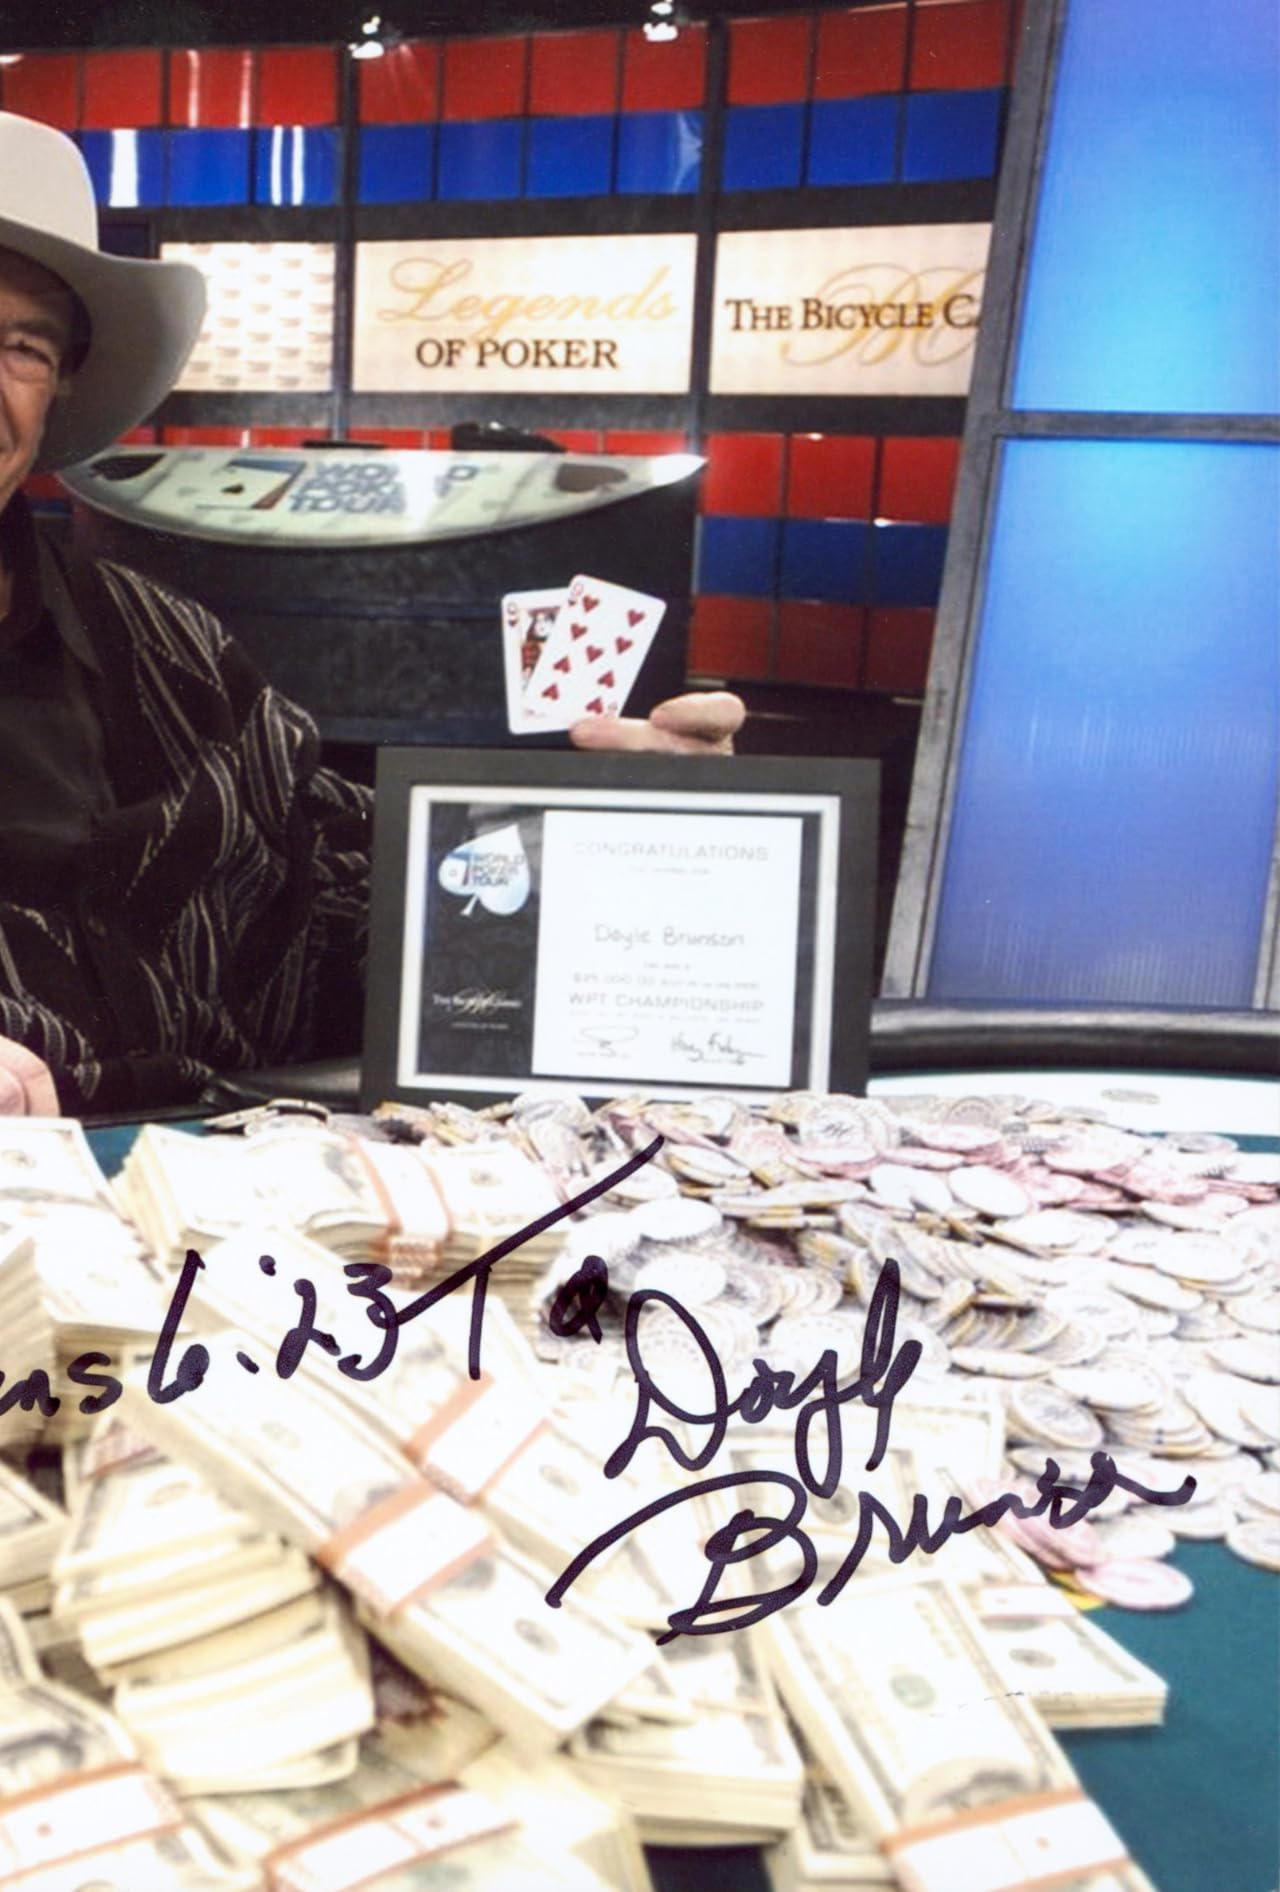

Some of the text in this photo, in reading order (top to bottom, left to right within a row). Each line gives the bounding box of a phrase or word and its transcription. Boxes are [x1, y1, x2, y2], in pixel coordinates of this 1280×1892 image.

[376, 256, 678, 343] Legends
[942, 293, 982, 330] C
[415, 337, 619, 369] OF POKER
[573, 841, 769, 862] CONGRATULATIONS
